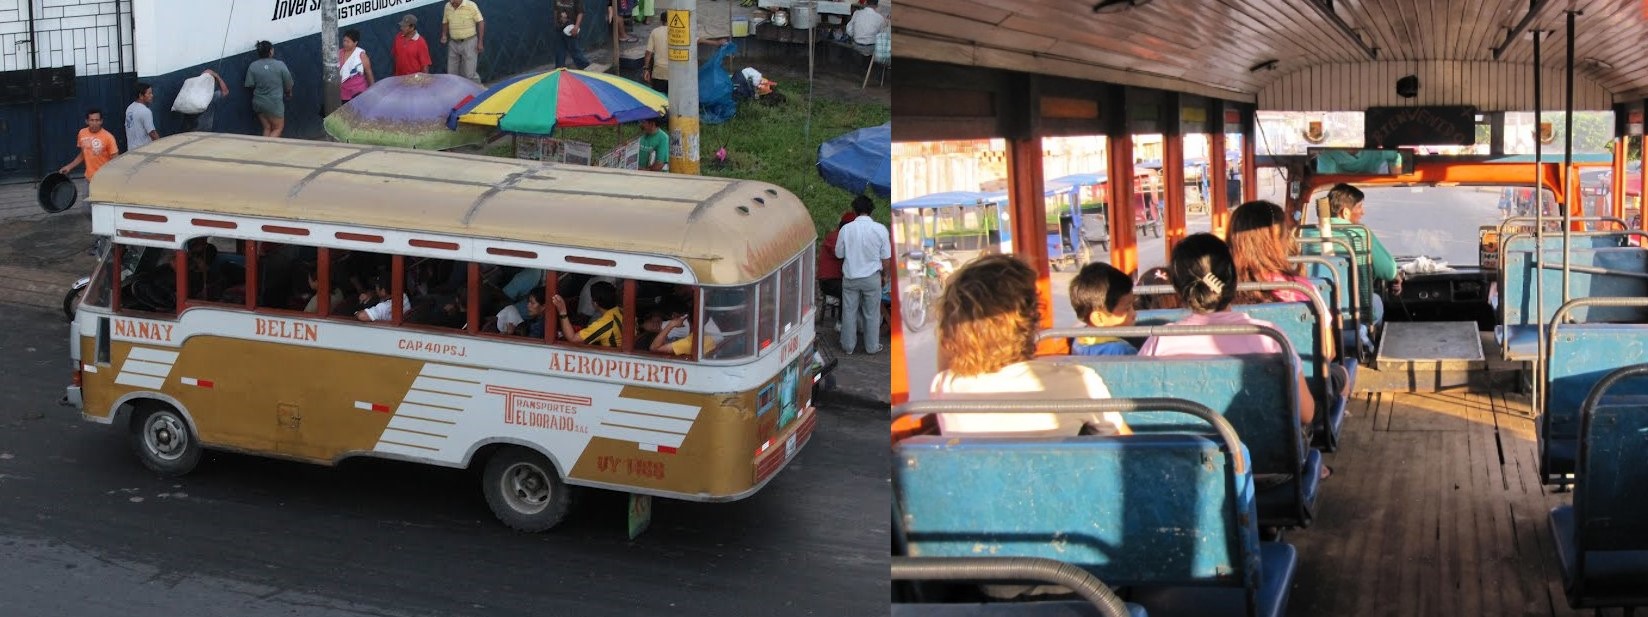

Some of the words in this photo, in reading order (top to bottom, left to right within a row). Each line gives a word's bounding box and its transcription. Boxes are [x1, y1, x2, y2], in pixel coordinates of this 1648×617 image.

[114, 318, 173, 342] NANAY
[255, 317, 318, 342] BELEN
[424, 342, 441, 353] 40
[549, 352, 688, 386] AEROPUERTO
[529, 411, 574, 432] DORADO
